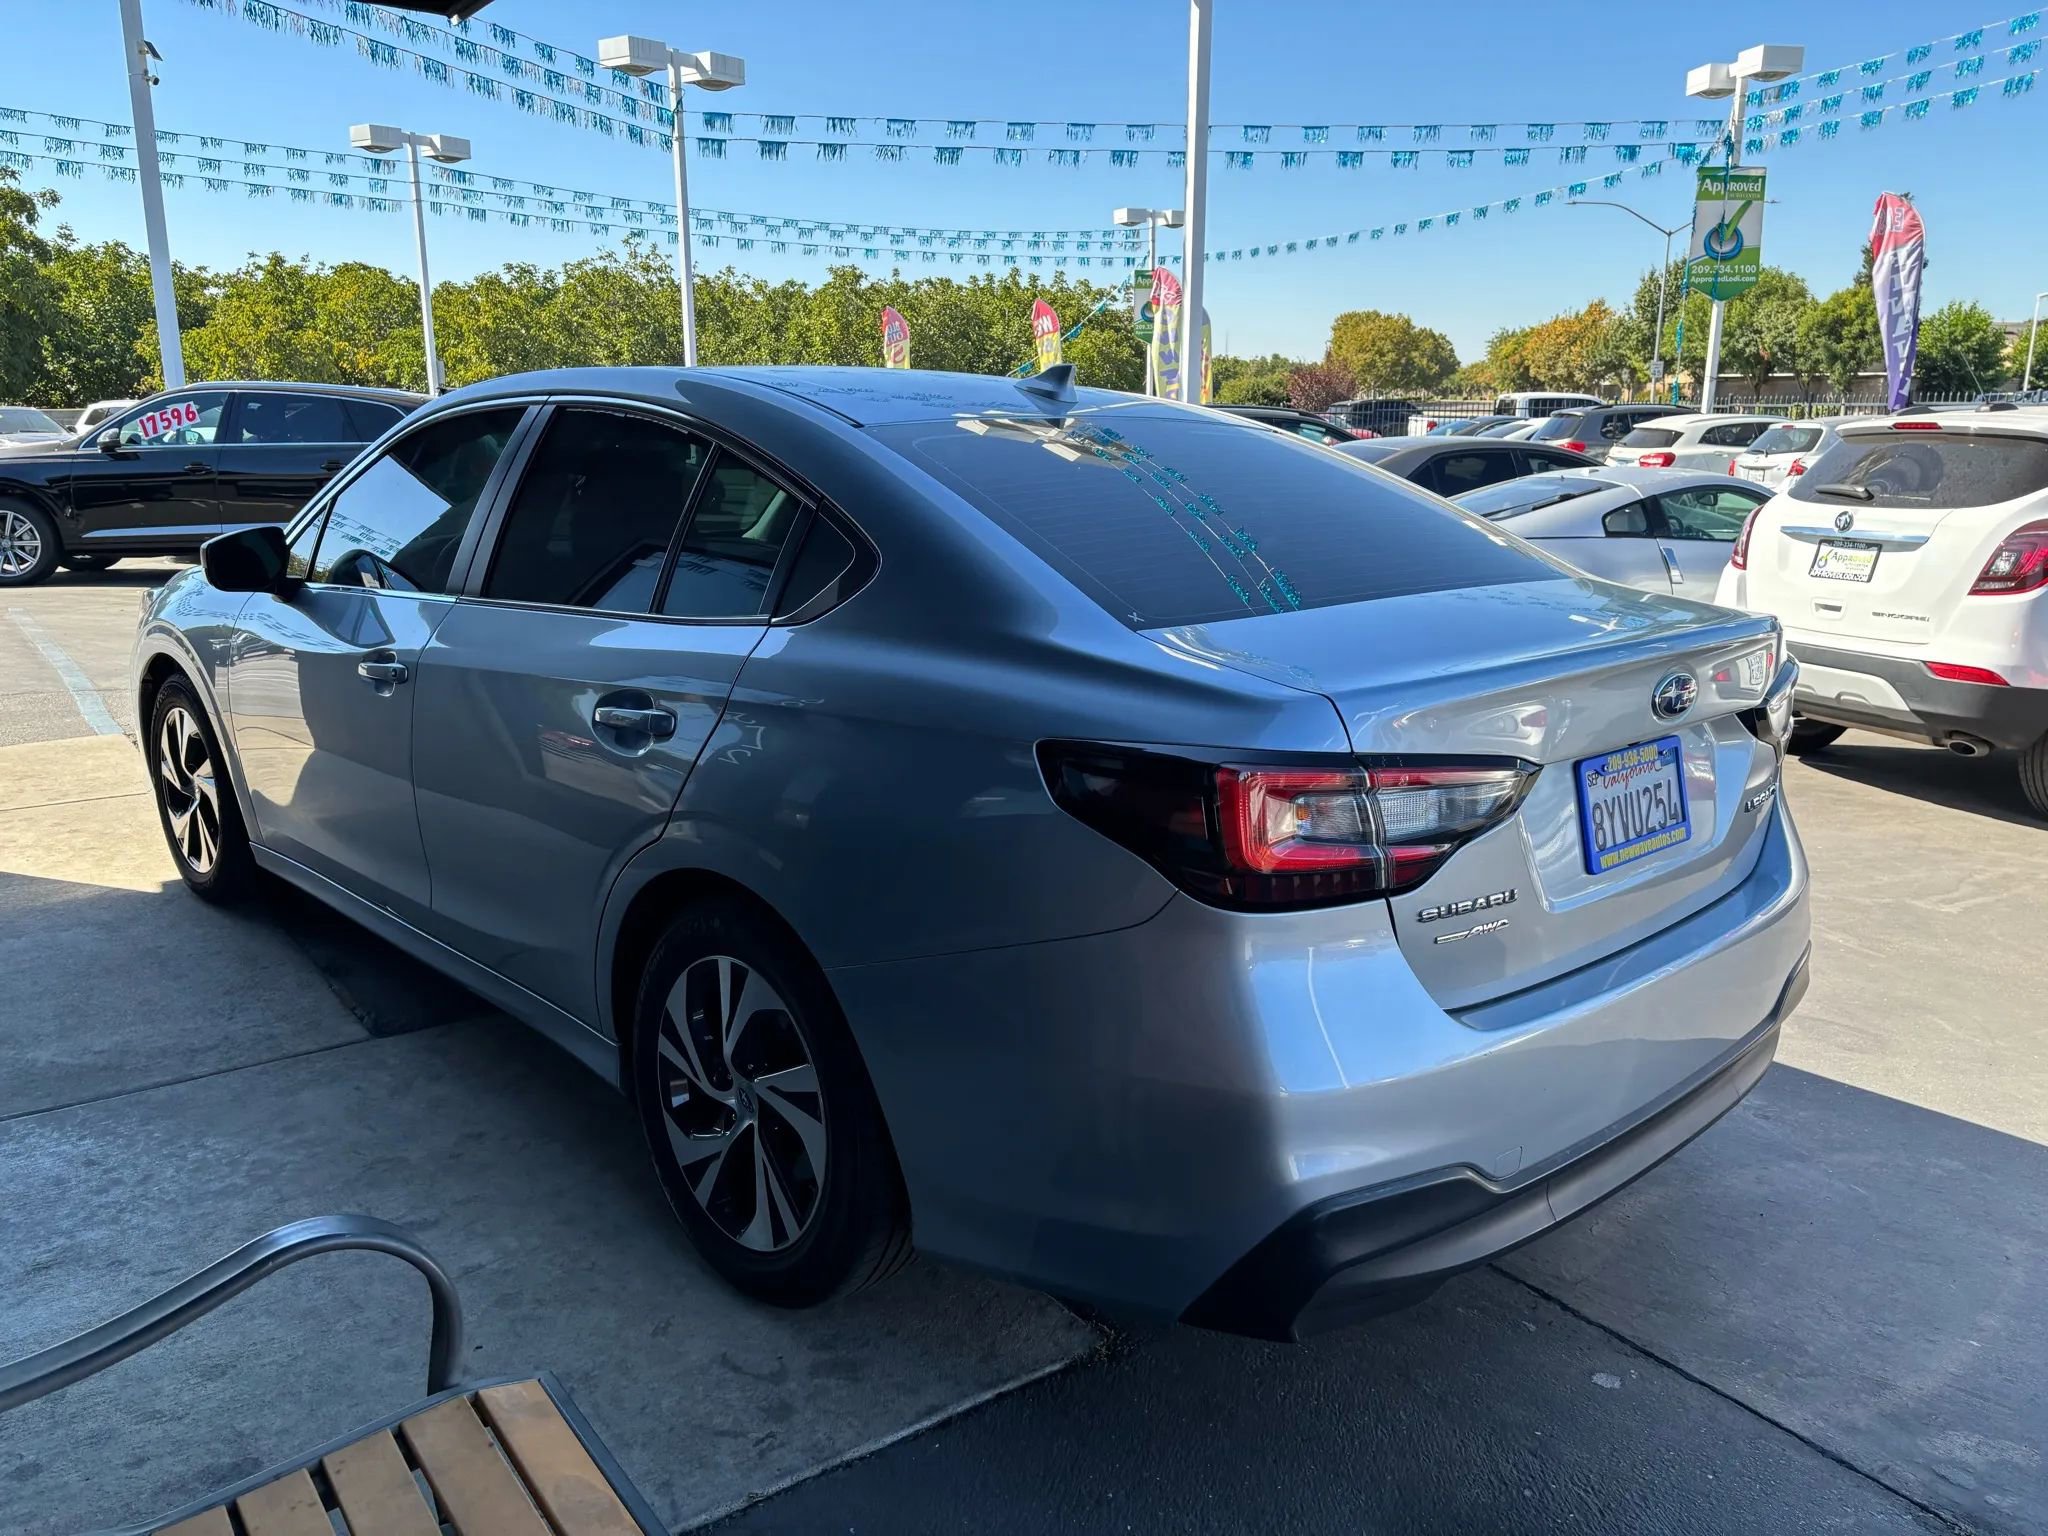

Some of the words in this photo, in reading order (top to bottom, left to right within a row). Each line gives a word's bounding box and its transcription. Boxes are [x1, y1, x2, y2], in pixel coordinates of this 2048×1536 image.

[1690, 275, 1757, 284] ApproedLodi.com
[138, 403, 198, 438] 17596
[1587, 771, 1599, 787] SEP
[1603, 761, 1662, 790] California
[1744, 784, 1776, 813] LEGAC
[1592, 779, 1679, 851] 8YVU254
[1600, 827, 1686, 869] www.newwaveautos.com
[1418, 888, 1519, 923] SUBARU
[1464, 919, 1509, 938] AWD
